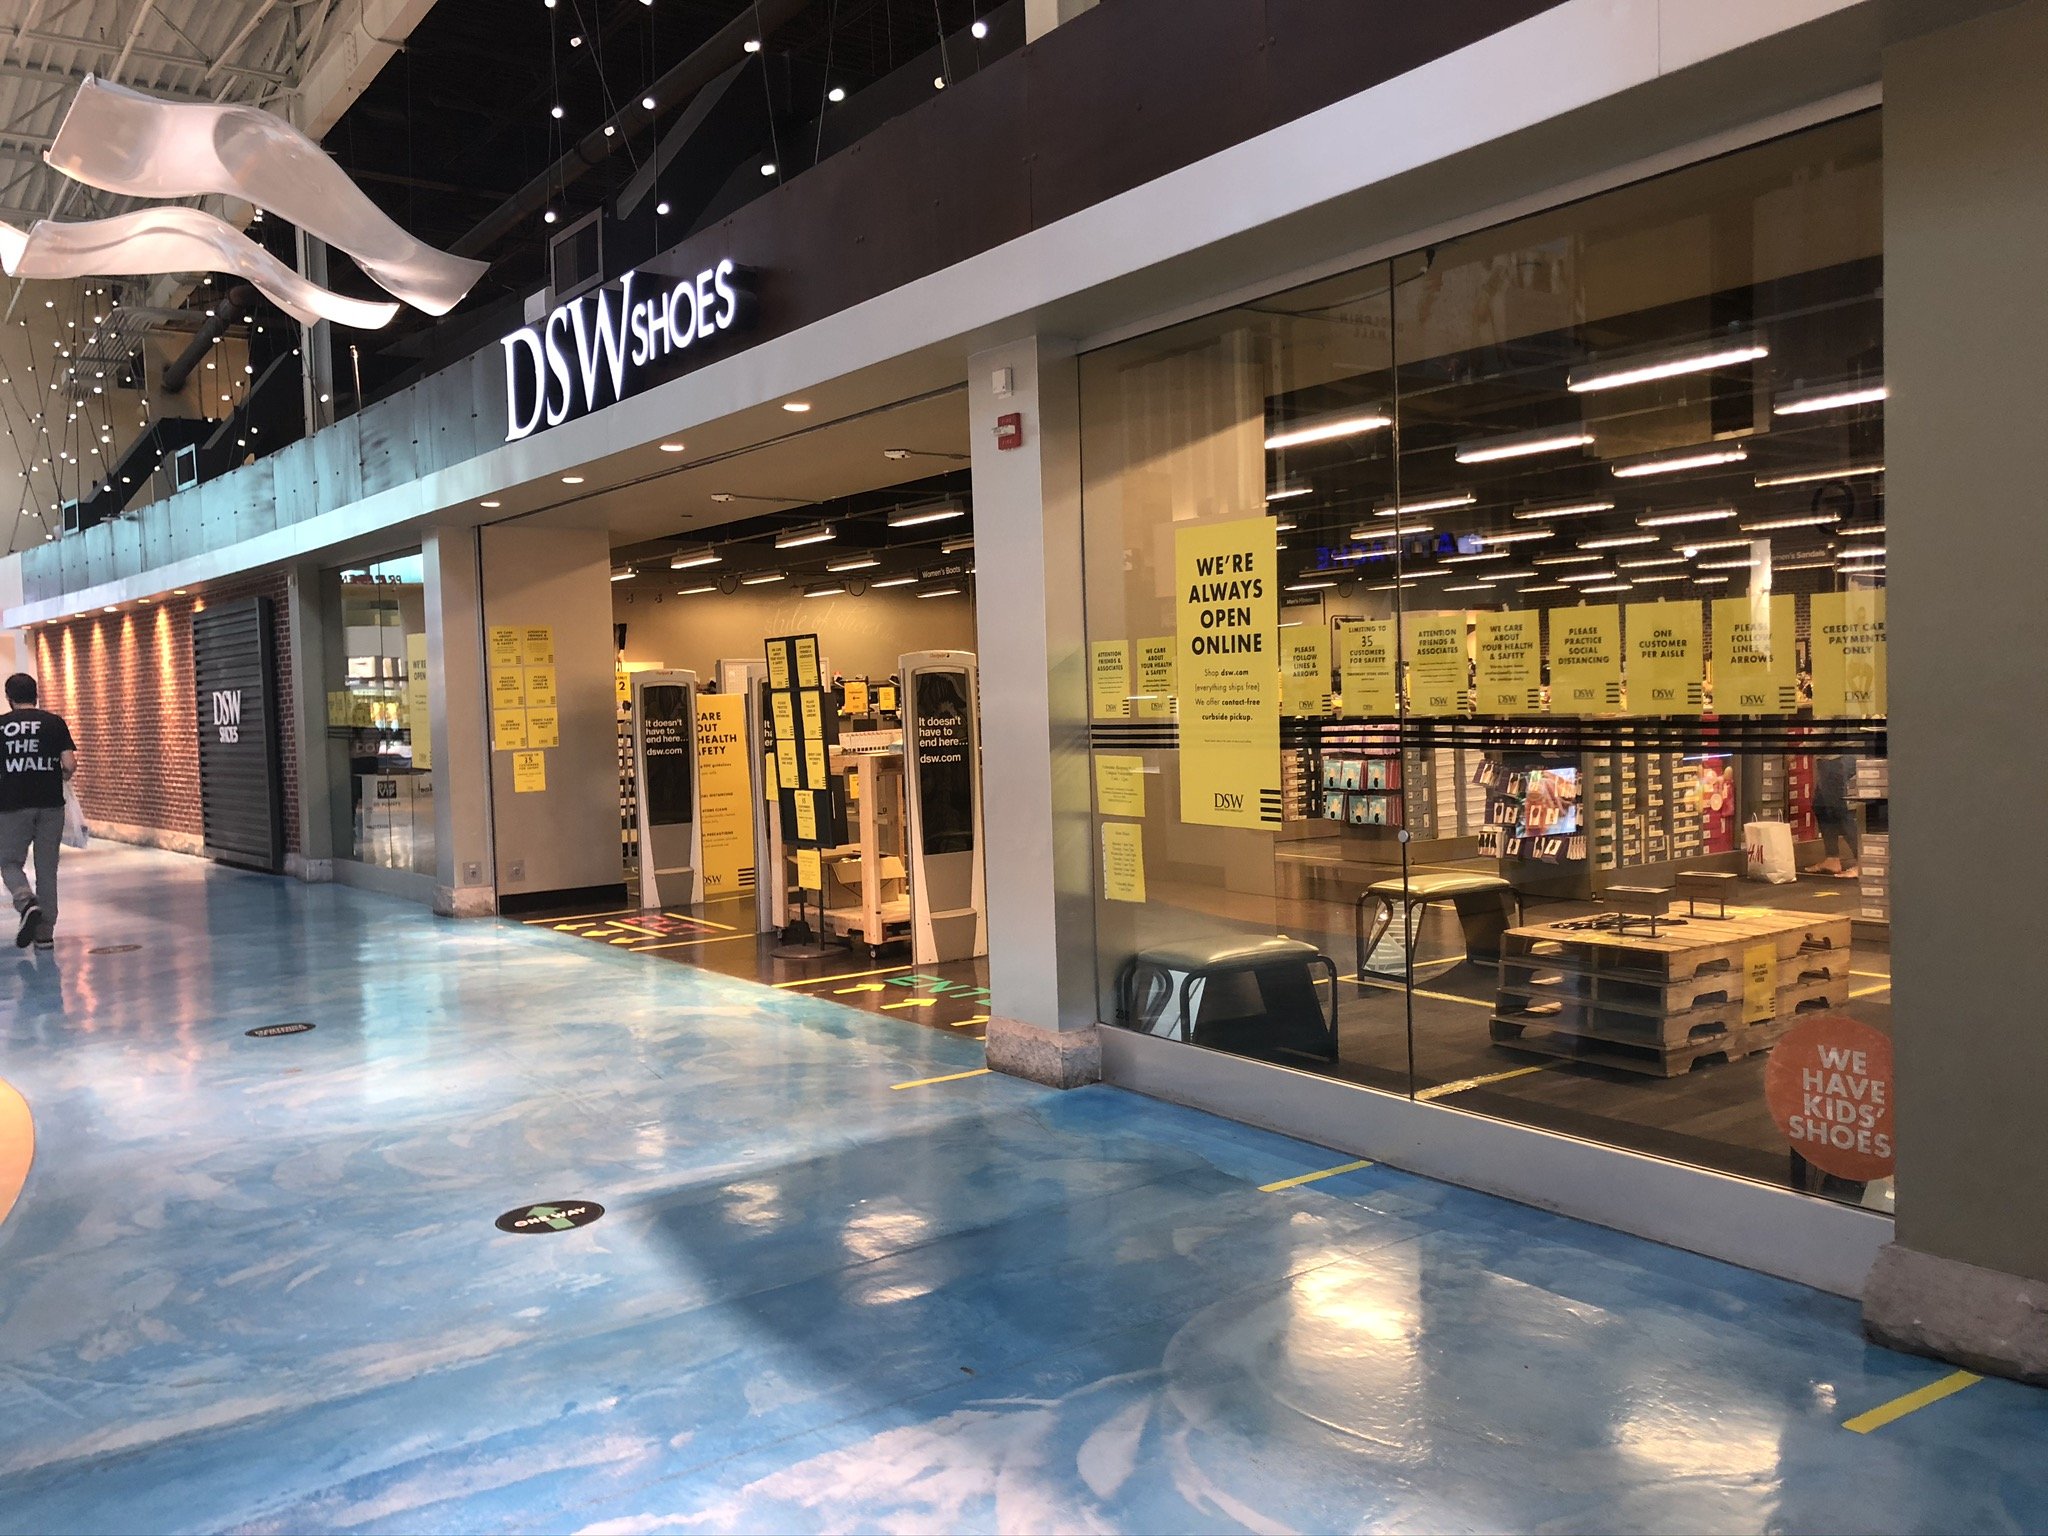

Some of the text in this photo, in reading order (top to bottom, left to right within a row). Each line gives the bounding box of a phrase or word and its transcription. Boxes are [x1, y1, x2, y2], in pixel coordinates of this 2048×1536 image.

[500, 258, 736, 442] DSW SHOES
[1196, 552, 1253, 577] WE'RE
[921, 566, 961, 579] Women's Boots
[1188, 578, 1263, 604] ALWAYS
[1200, 607, 1251, 629] OPEN
[1418, 629, 1457, 638] ATTENTION
[1489, 624, 1523, 633] WE CARE
[1568, 626, 1598, 636] PLEASE
[1653, 629, 1673, 638] ONE
[1822, 623, 1859, 634] CREDIT
[1361, 635, 1374, 648] 35
[1418, 638, 1448, 646] FRIENDS
[1494, 633, 1520, 642] ABOUT
[1564, 636, 1602, 645] PRACTICE
[1828, 633, 1887, 645] PAYMENTS
[1191, 633, 1262, 655] ONLINE
[1294, 645, 1315, 653] PLEASE
[1482, 642, 1533, 651] YOUR HEALTH
[1639, 639, 1687, 649] CUSTOMER
[1097, 650, 1122, 658] ATTENTION
[1349, 648, 1386, 656] CUSTOMERS
[1417, 646, 1458, 655] ASSOCIATES
[1568, 647, 1598, 655] SOCIAL
[1641, 649, 1685, 658] PER AISLE
[1842, 646, 1872, 655] ONLY
[1292, 654, 1318, 662] FOLLOW
[1363, 656, 1386, 664] SAFETY
[1497, 652, 1525, 660] SAFETY
[1558, 655, 1610, 665] DISTANCING
[1730, 654, 1774, 664] ARROWS
[1293, 662, 1311, 670] LINES
[1204, 668, 1249, 677] Shop dsw.com
[618, 681, 626, 691] 2
[1228, 682, 1244, 692] ships
[1573, 689, 1596, 699] DSW
[1652, 688, 1675, 698] DSW
[1194, 697, 1261, 706] We offer contact-free
[1298, 700, 1314, 709] DSW
[1429, 696, 1448, 706] DSW
[1497, 695, 1518, 704] DSW
[1740, 694, 1766, 705] DSW
[212, 690, 241, 726] DSW
[918, 715, 961, 727] It doesn't
[1201, 713, 1253, 722] curbside pickup.
[645, 718, 683, 728] It doesn't
[764, 719, 771, 729] It
[646, 728, 665, 736] have
[919, 726, 953, 737] have to
[646, 735, 689, 744] end here...
[698, 734, 737, 745] HEALTH
[919, 736, 969, 748] end here...
[5, 738, 40, 755] THE
[646, 747, 683, 756] dsw.com
[920, 753, 961, 764] dsw.com
[1214, 793, 1244, 809] DSW
[1817, 1044, 1868, 1076] WE
[1802, 1067, 1885, 1105] HAVE
[1803, 1092, 1886, 1129] KIDS'
[1788, 1115, 1892, 1159] SHOES
